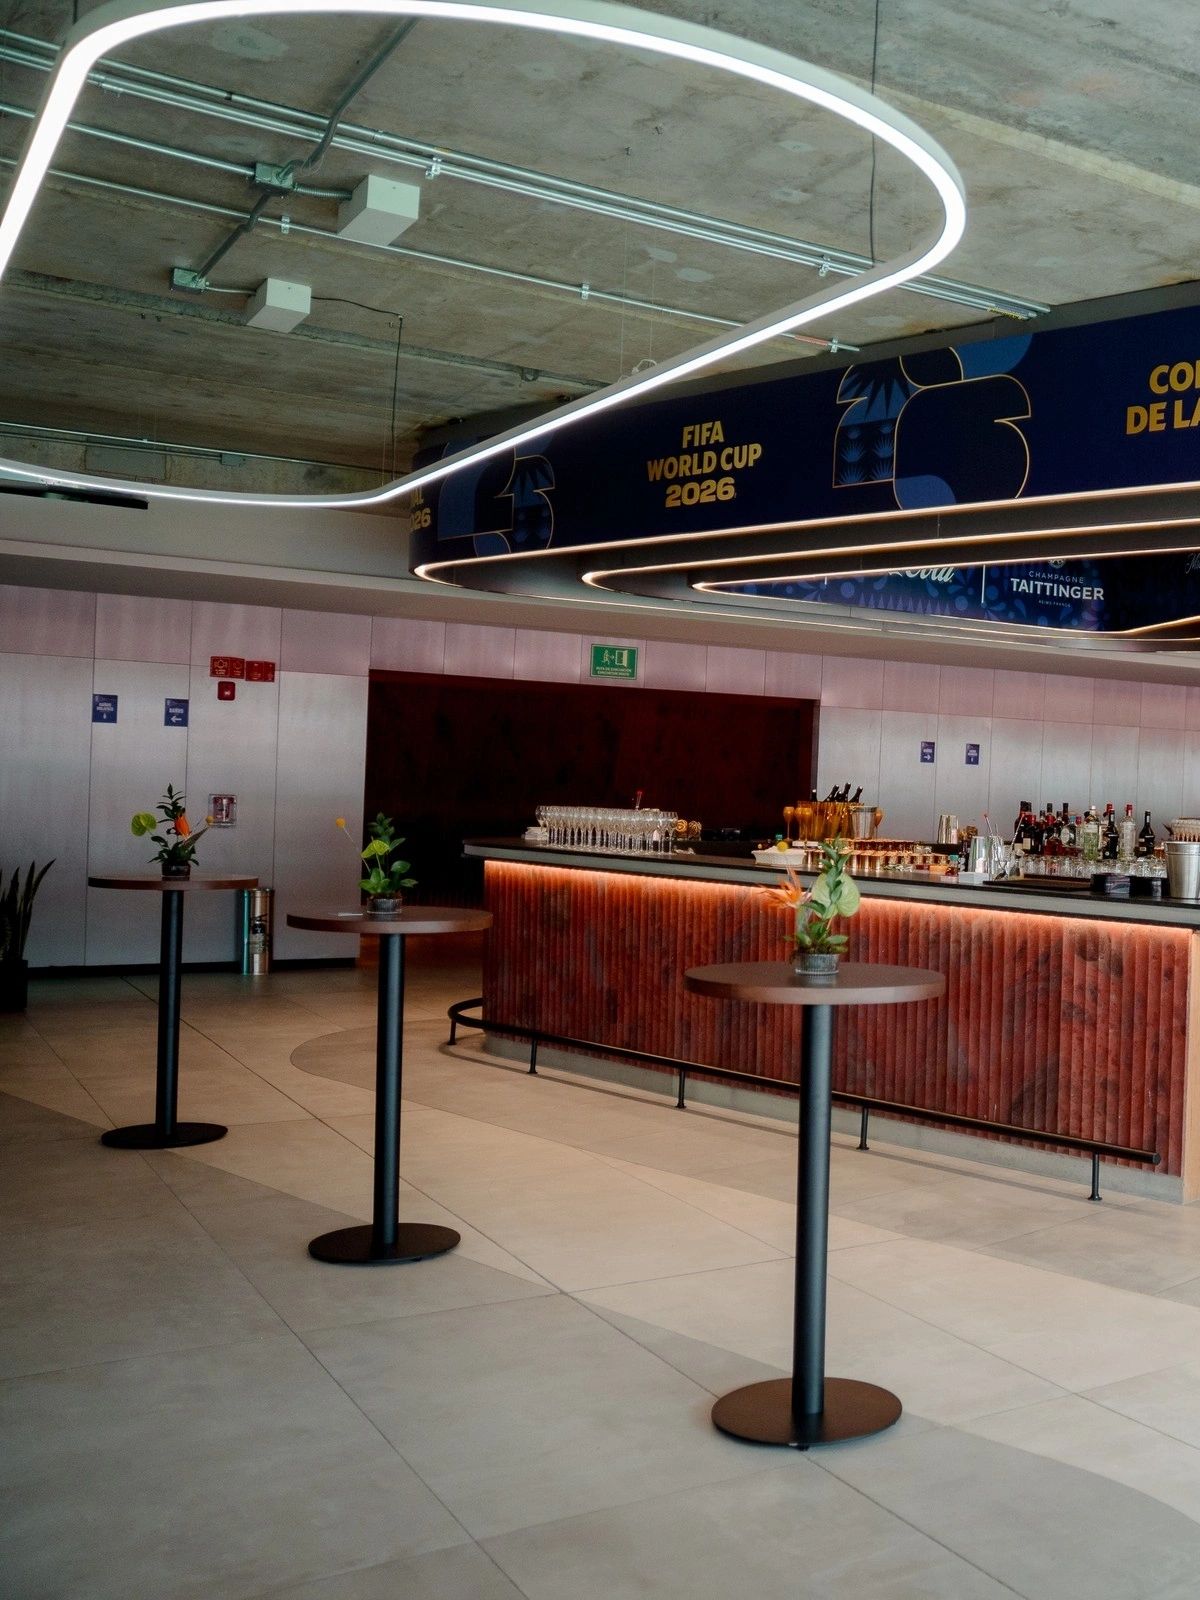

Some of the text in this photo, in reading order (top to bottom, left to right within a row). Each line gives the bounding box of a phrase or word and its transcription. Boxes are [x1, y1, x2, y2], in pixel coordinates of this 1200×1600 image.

[1126, 402, 1167, 435] DE
[682, 420, 724, 449] FIFA
[647, 443, 762, 482] WORLD CUP
[665, 476, 735, 508] 2026
[1010, 577, 1105, 601] TAITTINGER
[1028, 570, 1084, 584] CHAMPAGNE
